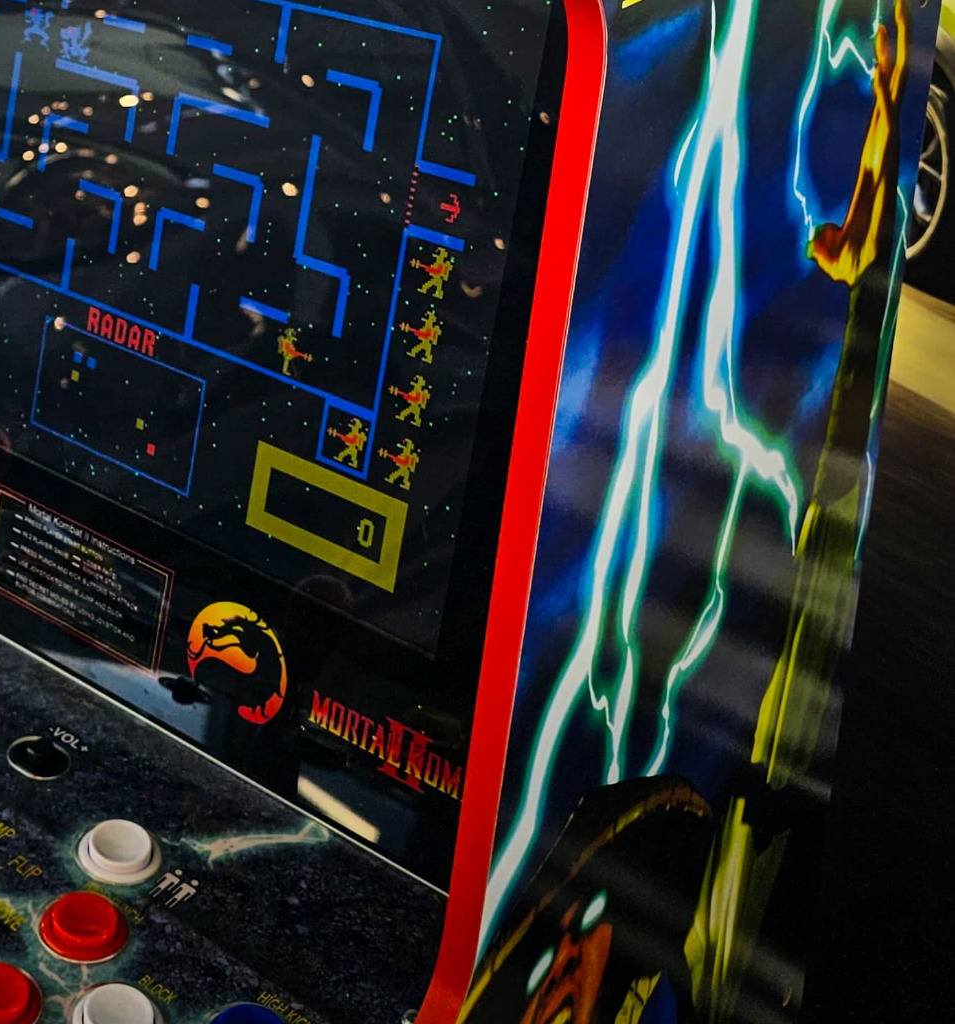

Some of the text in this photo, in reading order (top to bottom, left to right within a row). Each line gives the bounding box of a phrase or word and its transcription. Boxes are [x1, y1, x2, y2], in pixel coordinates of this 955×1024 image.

[86, 306, 156, 357] RADAR
[28, 502, 52, 522] Mortal
[53, 515, 82, 538] Kombat
[90, 536, 136, 565] Instructions
[357, 518, 374, 548] 0
[308, 689, 462, 801] MORTAL KOM
[7, 855, 43, 880] FLIP
[138, 974, 178, 1005] BLOCK
